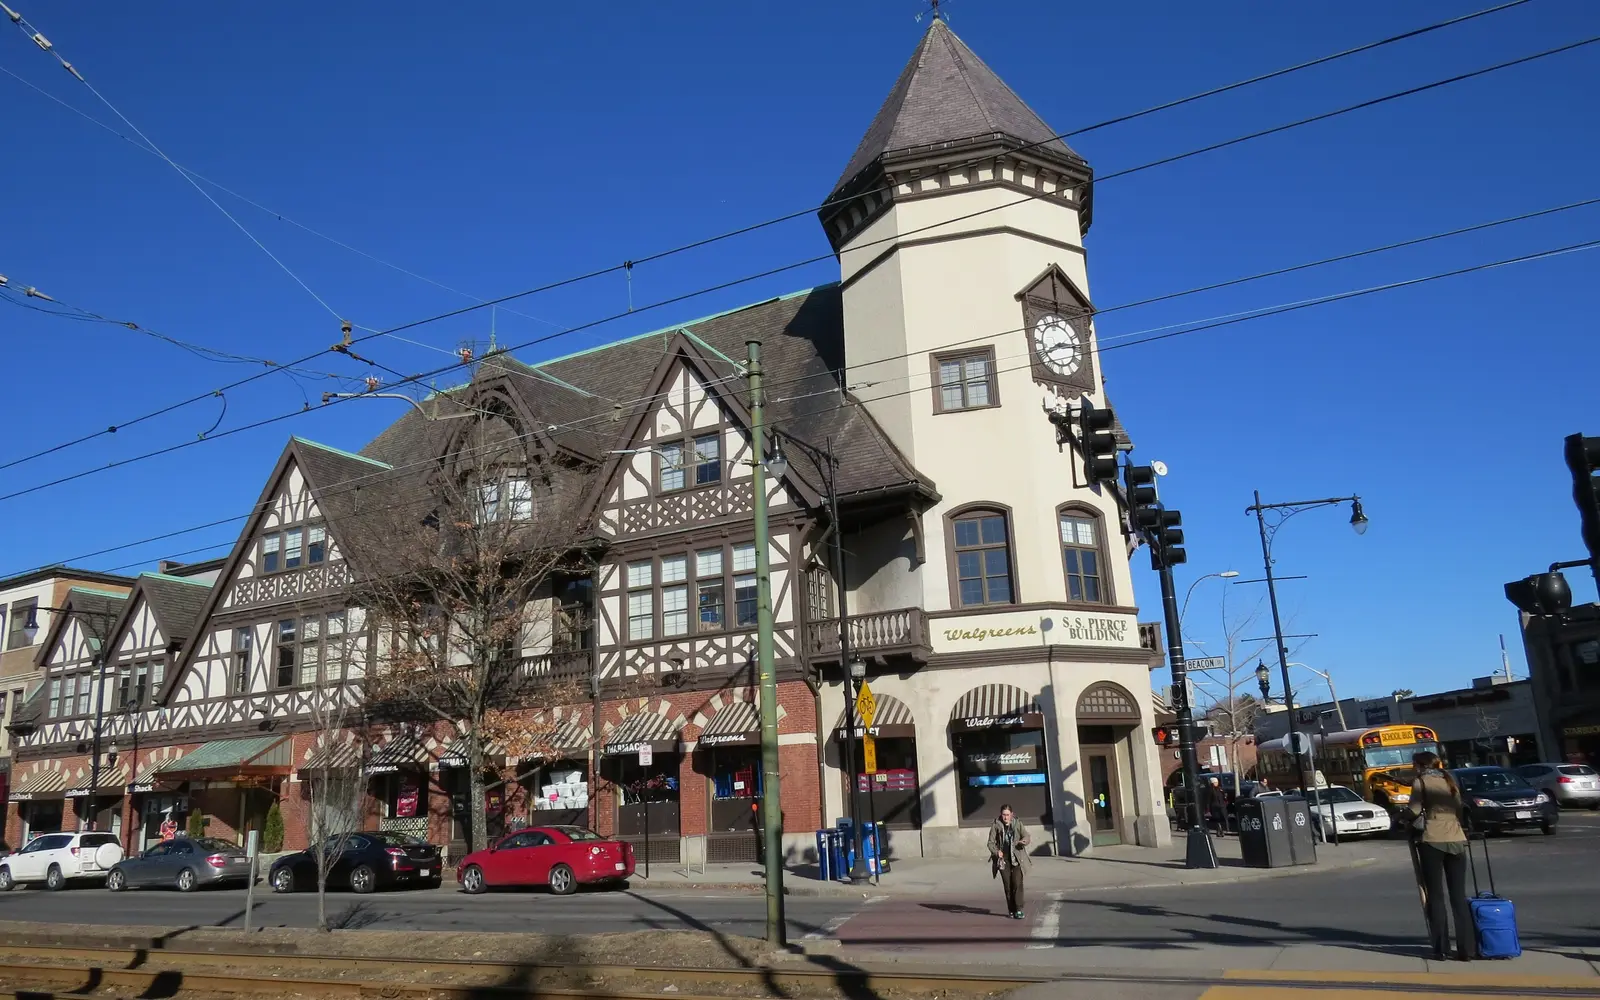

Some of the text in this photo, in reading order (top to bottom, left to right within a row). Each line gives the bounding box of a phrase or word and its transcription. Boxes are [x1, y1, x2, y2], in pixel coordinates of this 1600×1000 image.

[1062, 616, 1127, 631] S. S. PIERCE
[943, 625, 1037, 641] Walgreens
[1069, 627, 1124, 642] BUILDING
[1188, 660, 1214, 669] BEACON
[965, 717, 1024, 728] Walgreens
[840, 727, 880, 738] PHMCY
[1382, 731, 1413, 741] SCHOOL BUS
[700, 734, 746, 746] Walgreens
